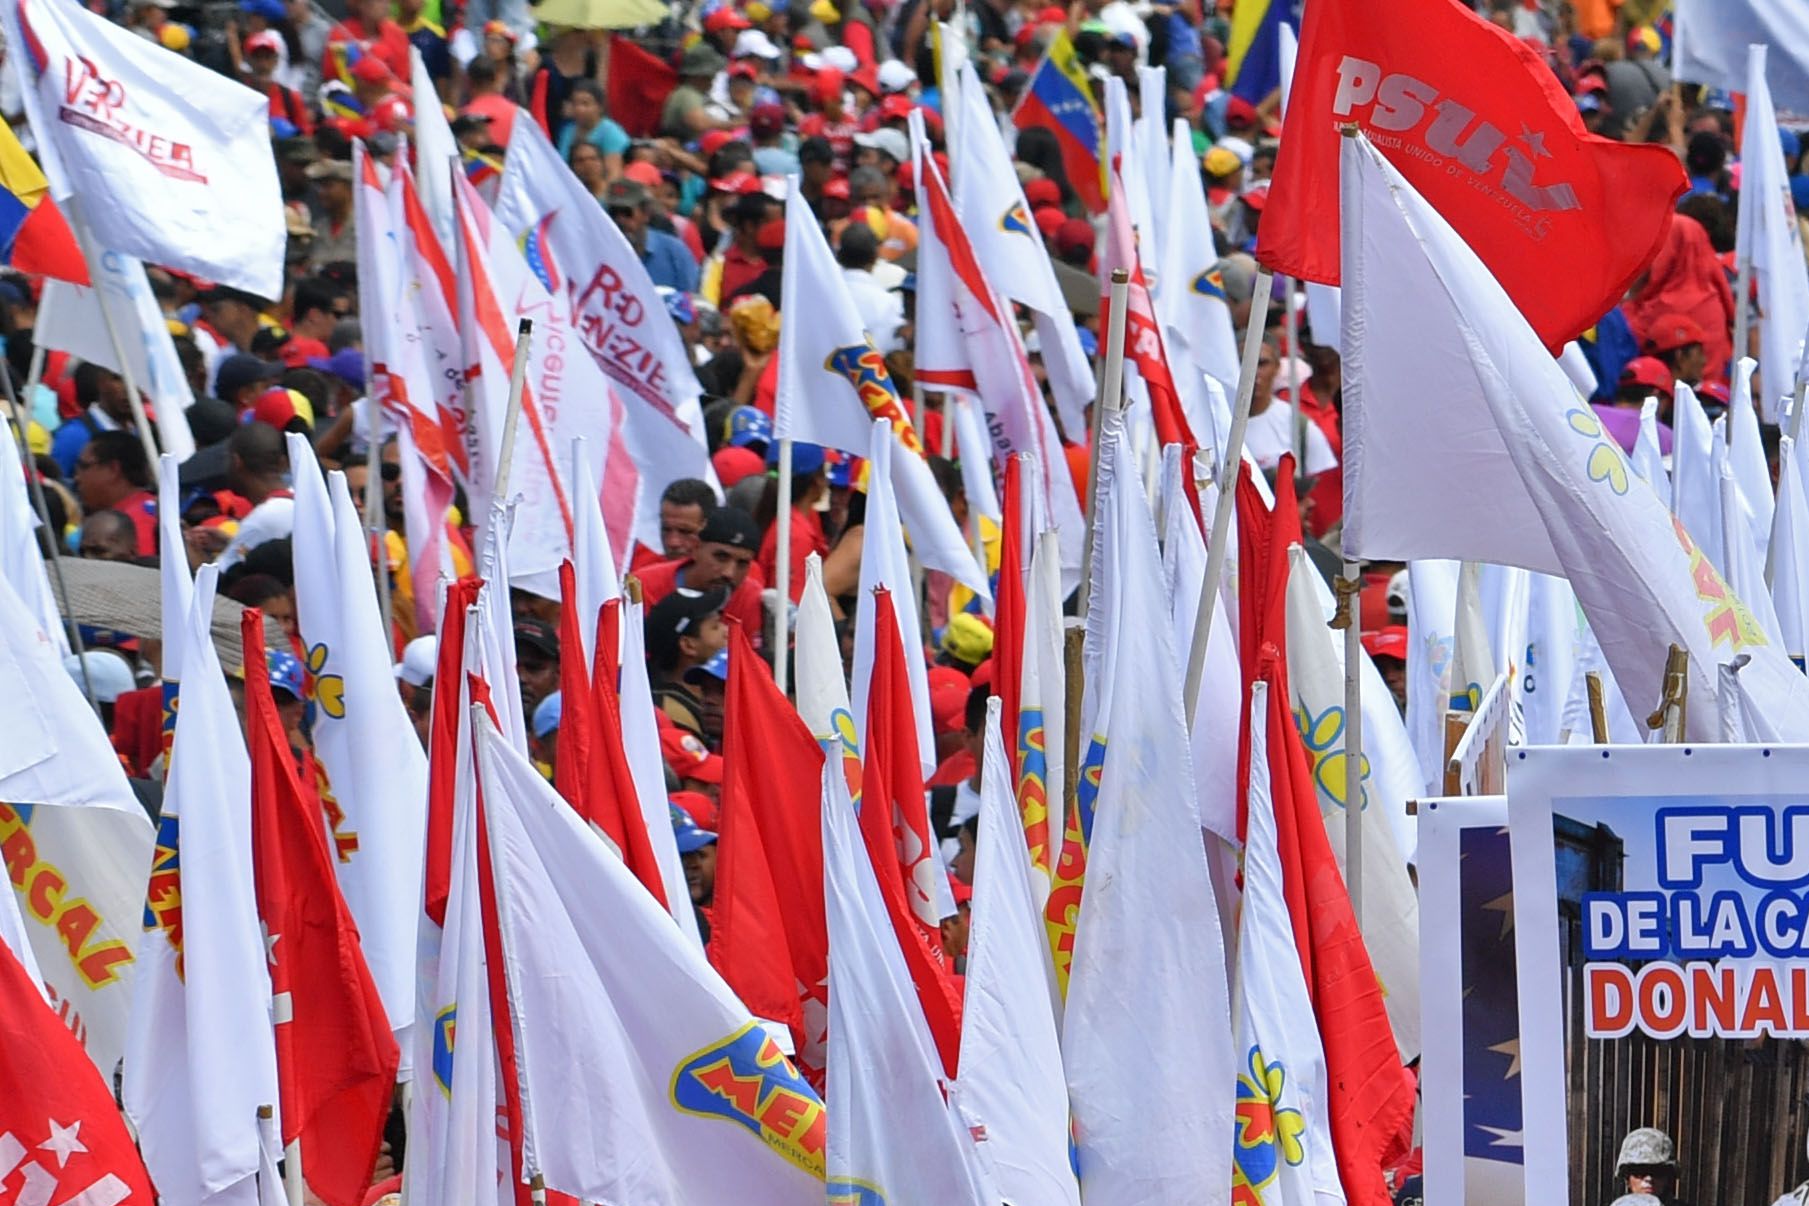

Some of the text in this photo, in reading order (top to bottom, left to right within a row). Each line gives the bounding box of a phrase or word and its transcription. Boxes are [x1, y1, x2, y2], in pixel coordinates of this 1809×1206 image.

[1405, 144, 1442, 168] UNIDO
[0, 800, 136, 992] RCAL
[1588, 897, 1664, 954] DE
[1678, 897, 1749, 953] LA
